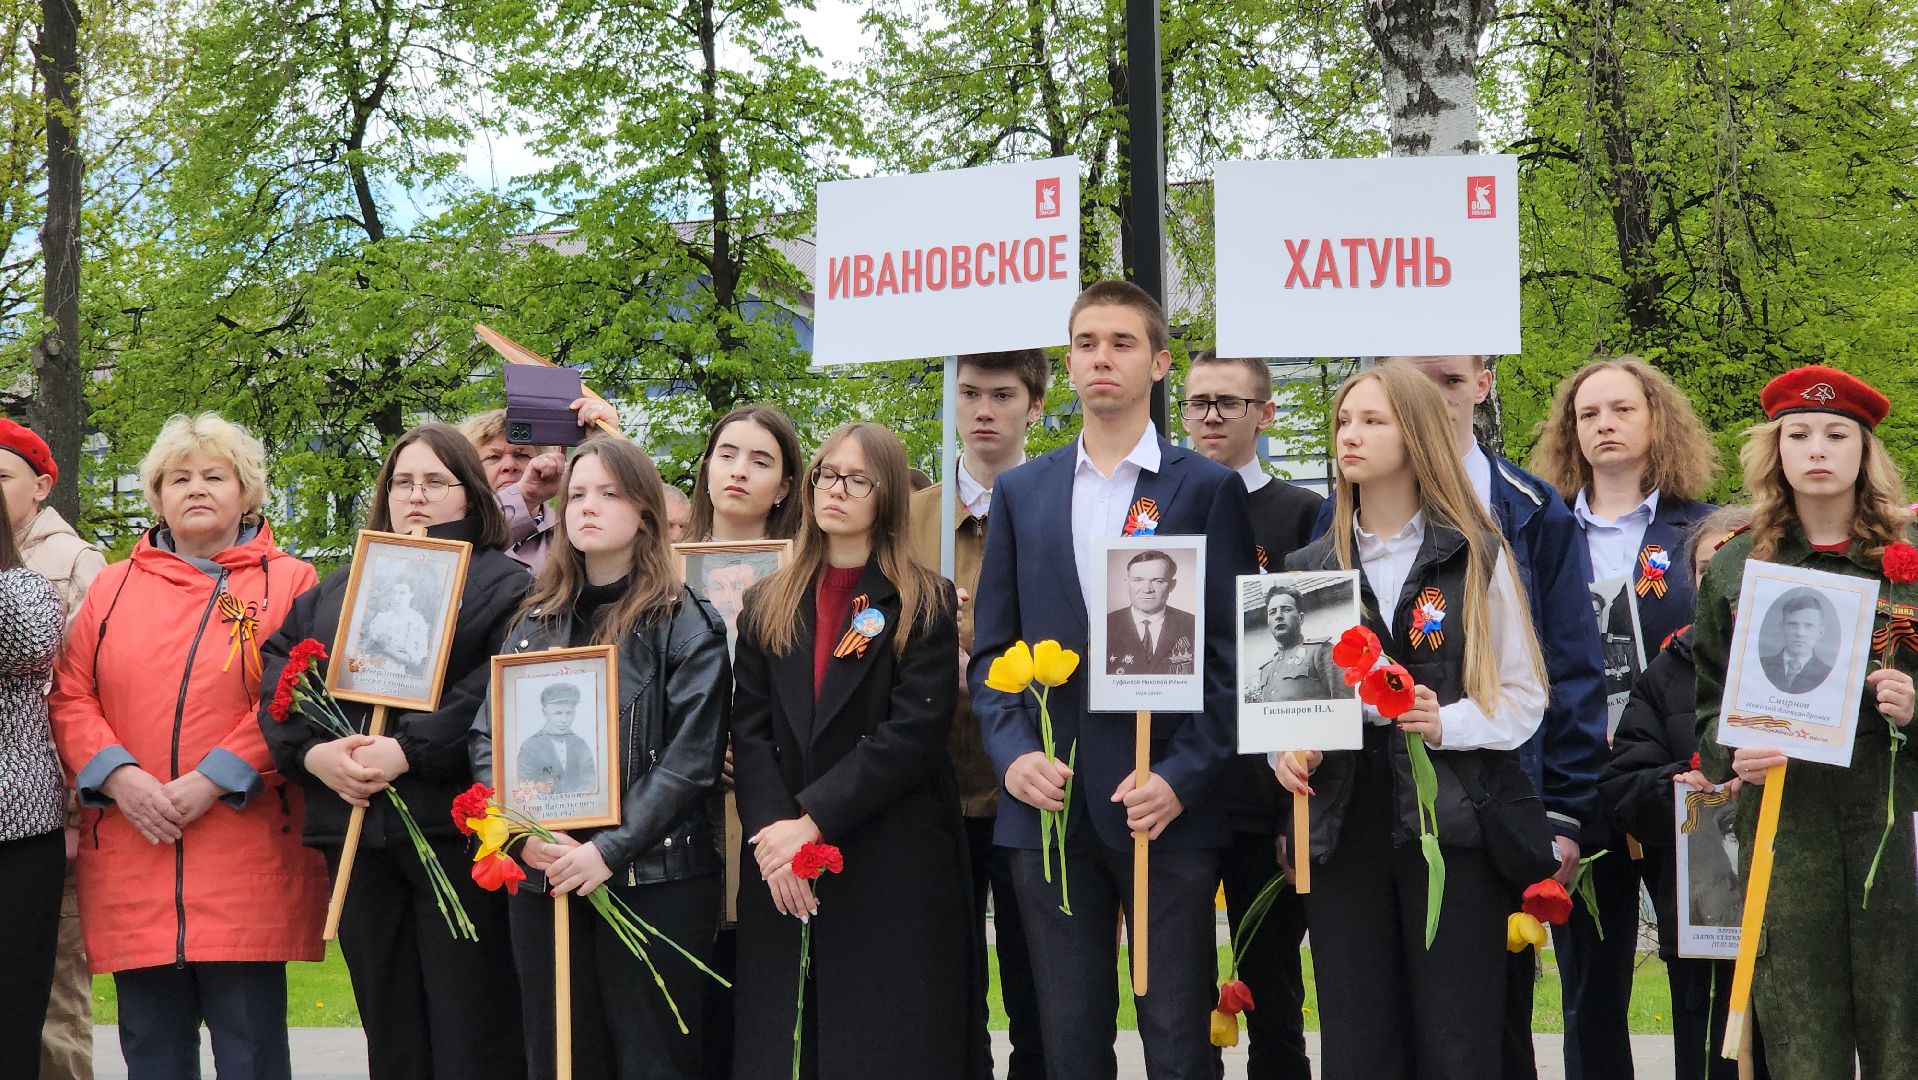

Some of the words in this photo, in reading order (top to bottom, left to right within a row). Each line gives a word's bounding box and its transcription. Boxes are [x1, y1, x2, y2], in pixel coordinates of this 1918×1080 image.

[829, 234, 1068, 299] ИВАНОВСКОЕ
[1284, 236, 1452, 289] ХАТУНЬ
[1314, 704, 1335, 713] Н.А.
[1768, 695, 1810, 709] Смирнов
